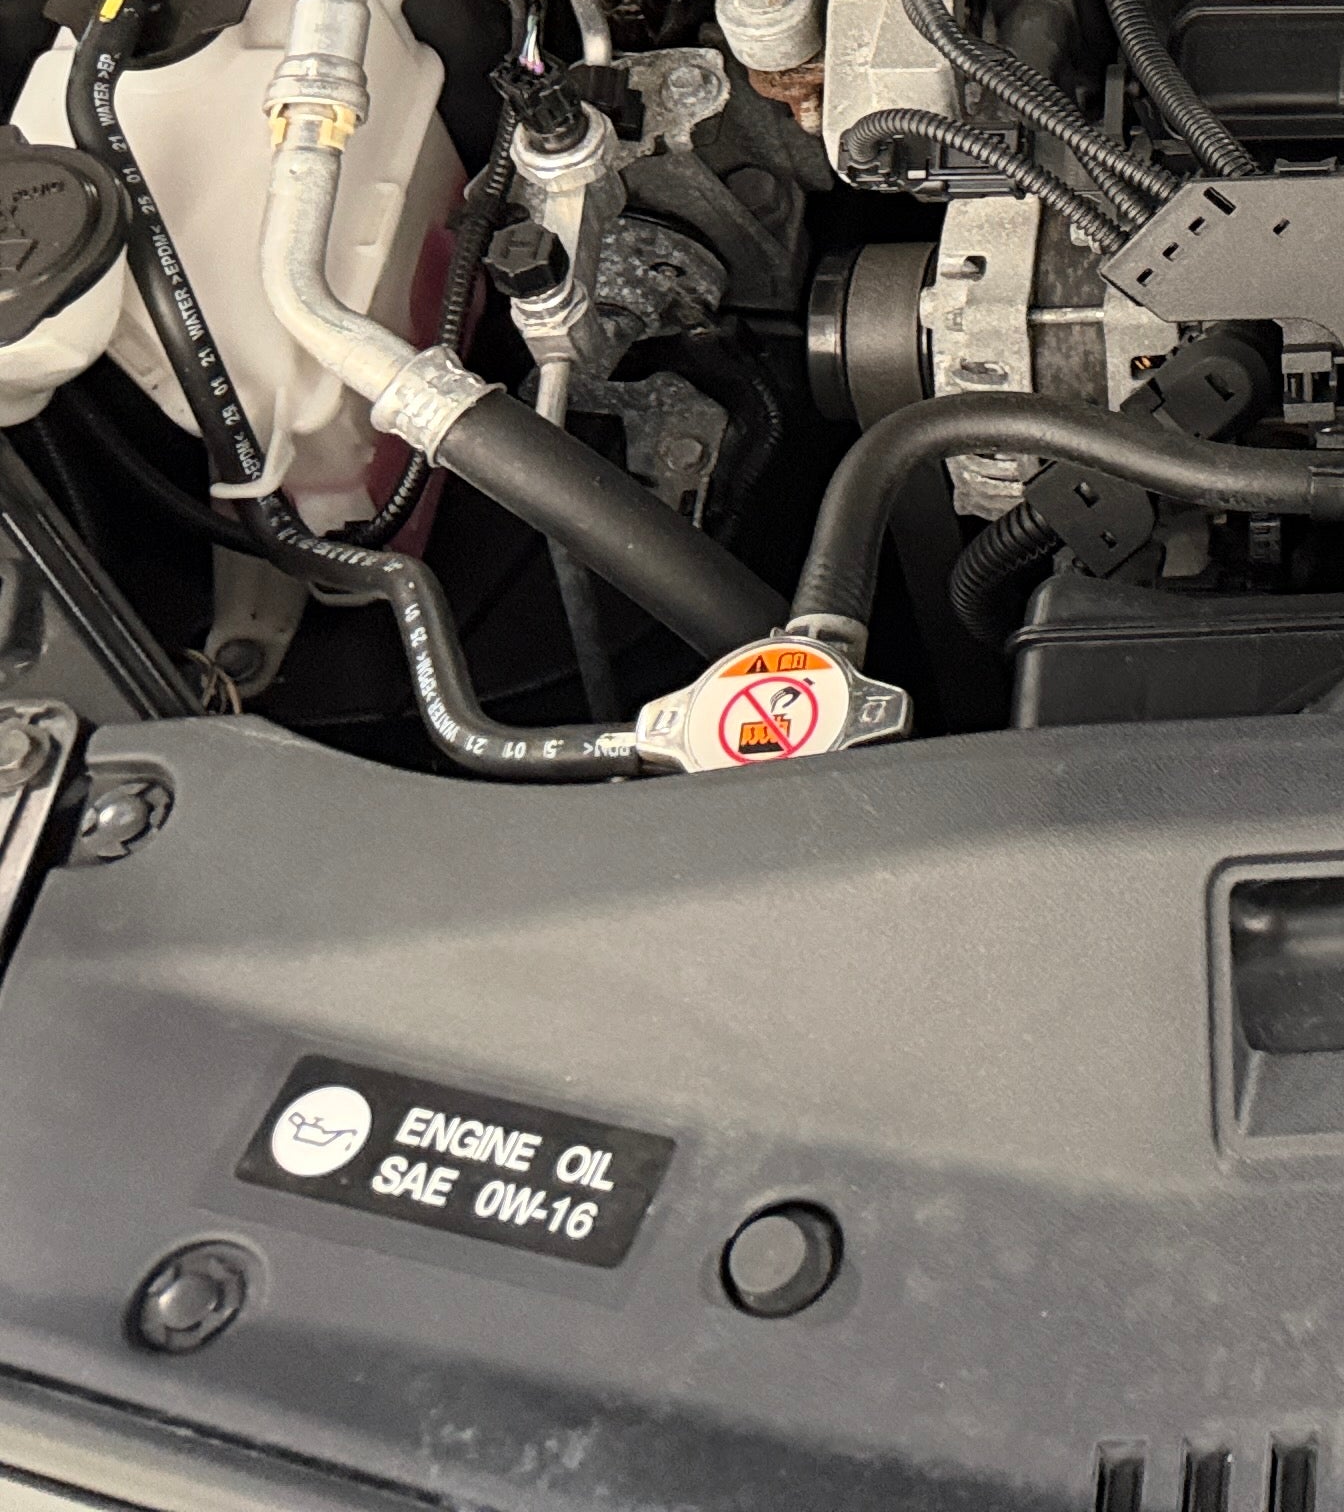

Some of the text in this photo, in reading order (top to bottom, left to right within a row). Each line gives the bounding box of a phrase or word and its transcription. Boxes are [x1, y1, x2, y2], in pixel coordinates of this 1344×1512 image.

[93, 82, 117, 127] WATER
[108, 135, 128, 153] 21
[122, 167, 141, 183] 01
[137, 195, 156, 215] 25
[175, 287, 205, 341] WATER
[395, 1107, 617, 1192] ENGINE OIL
[371, 1155, 598, 1241] SAE 0W-16
